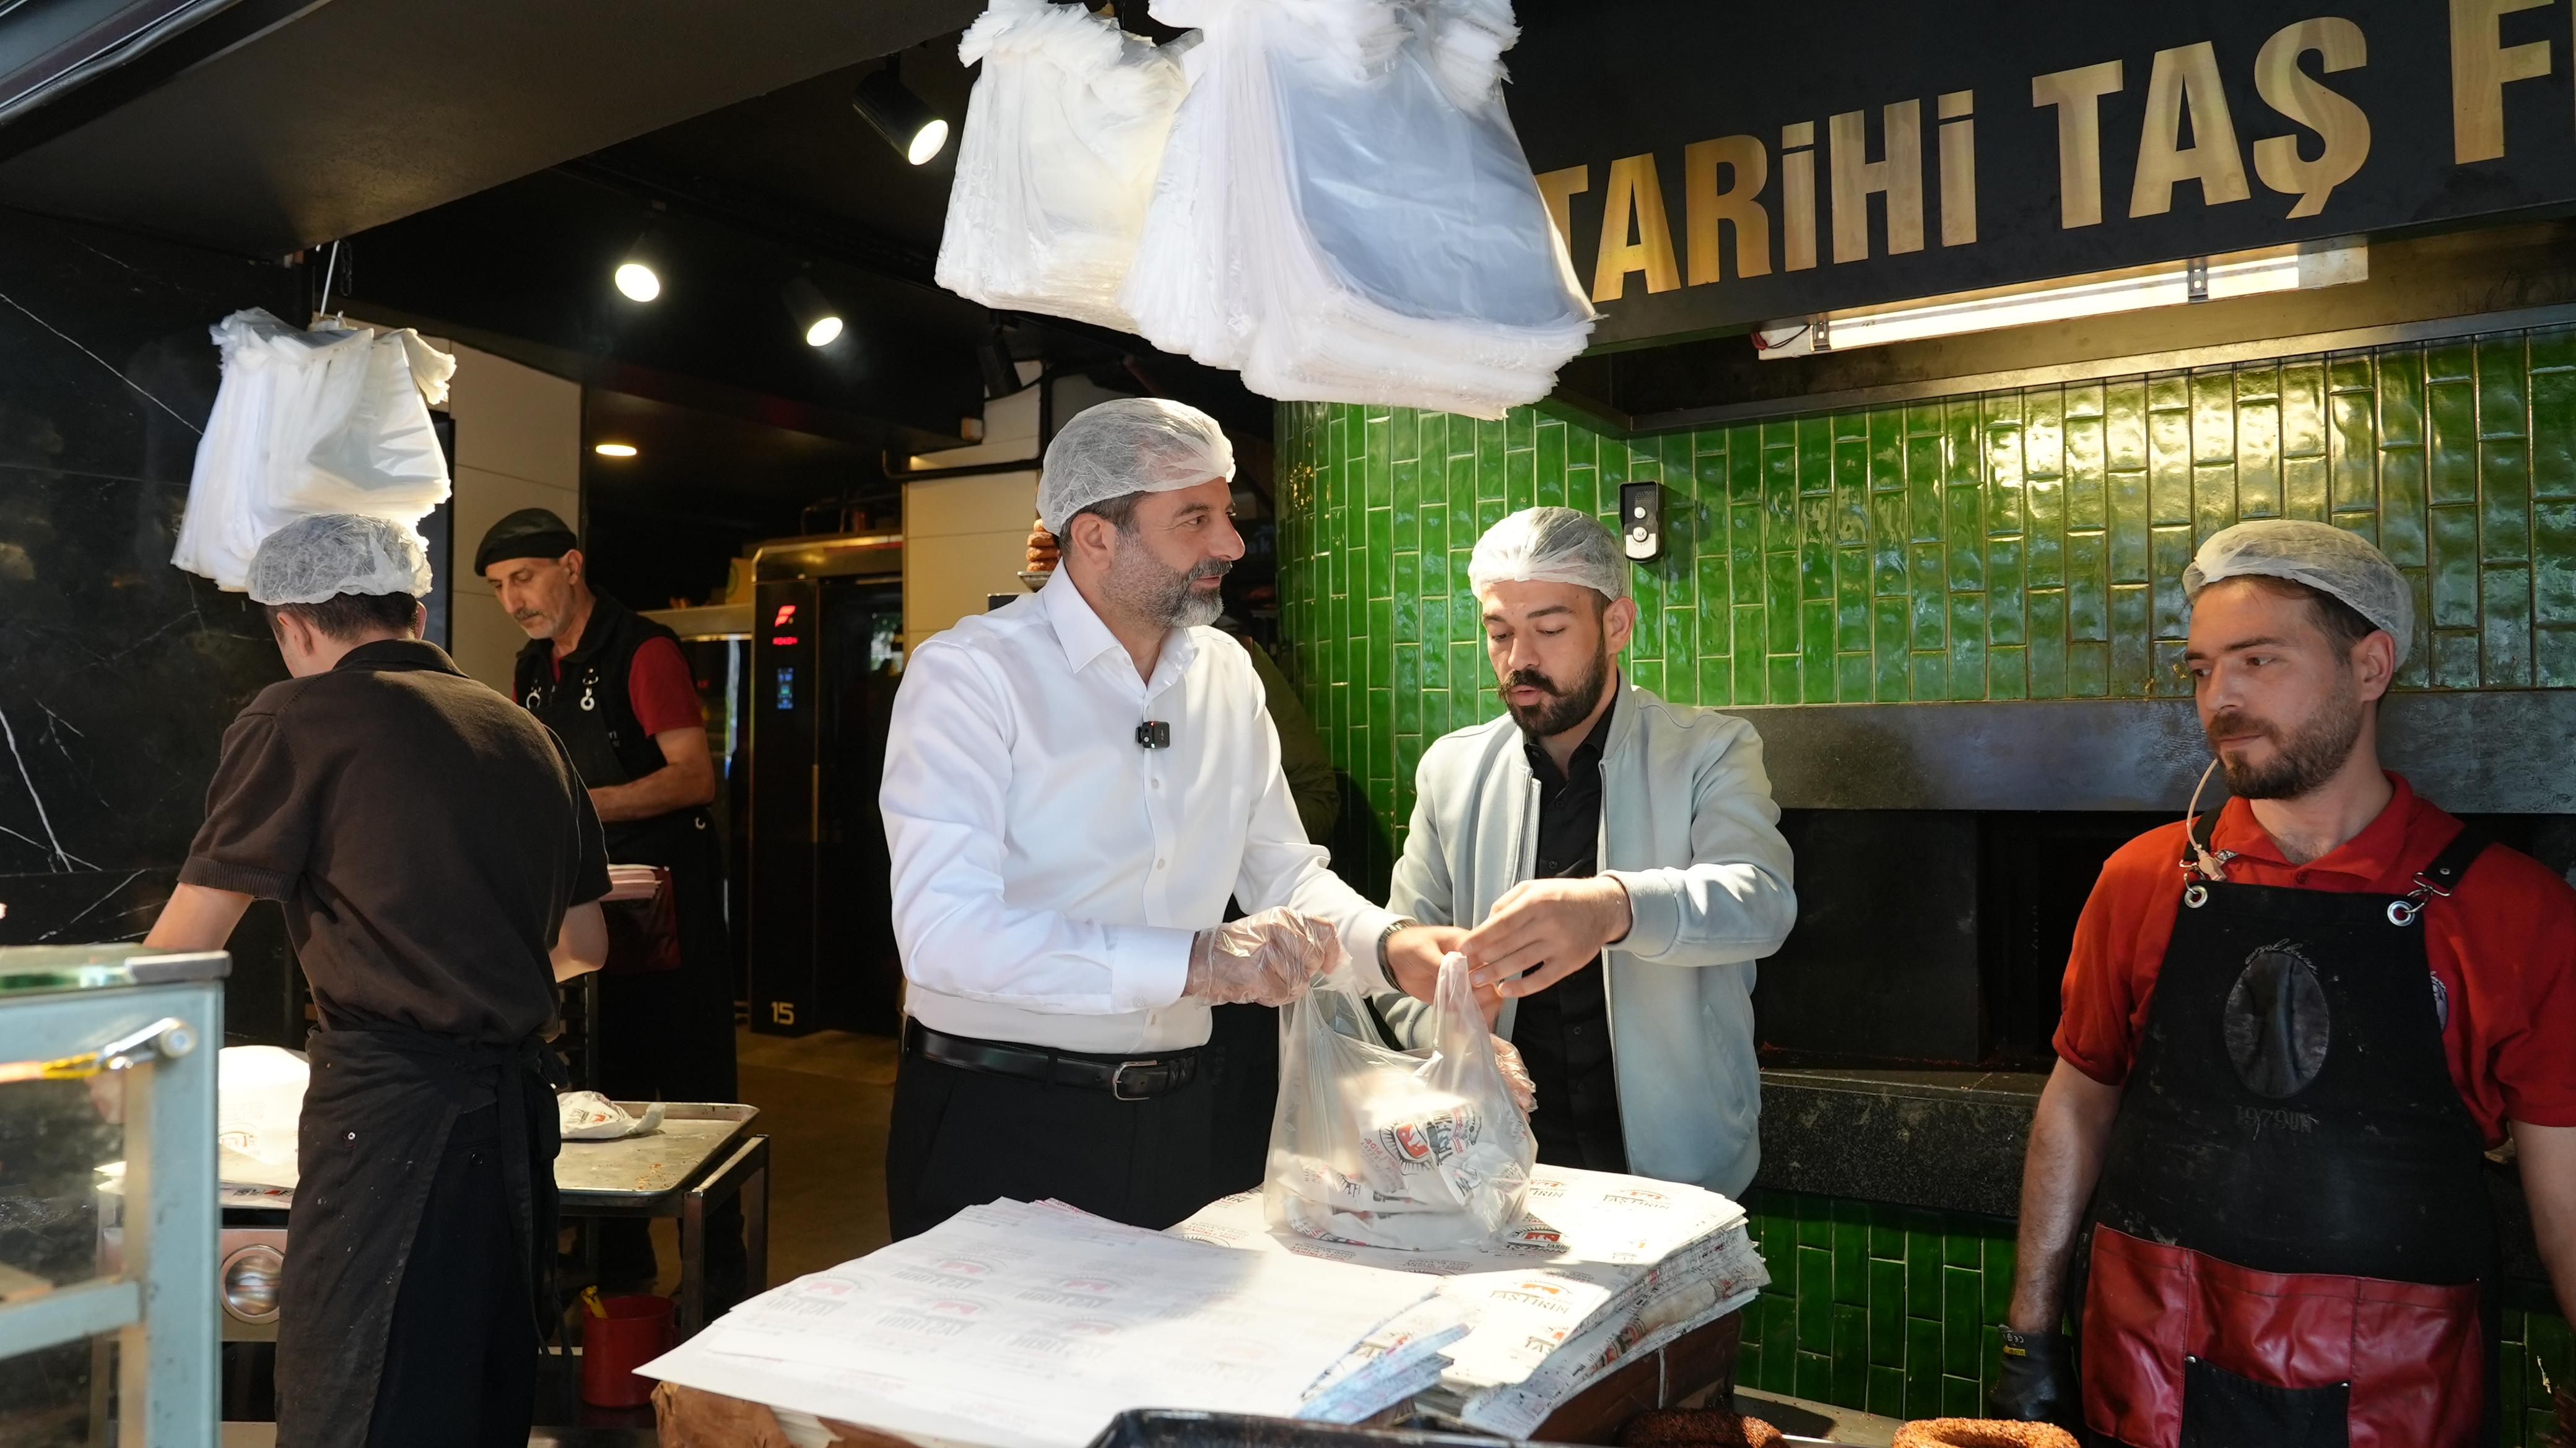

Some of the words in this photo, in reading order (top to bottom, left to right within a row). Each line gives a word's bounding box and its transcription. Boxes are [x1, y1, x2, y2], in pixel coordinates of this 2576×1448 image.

[2032, 17, 2371, 229] TAŞ
[2449, 0, 2576, 164] F
[772, 1001, 794, 1025] 15
